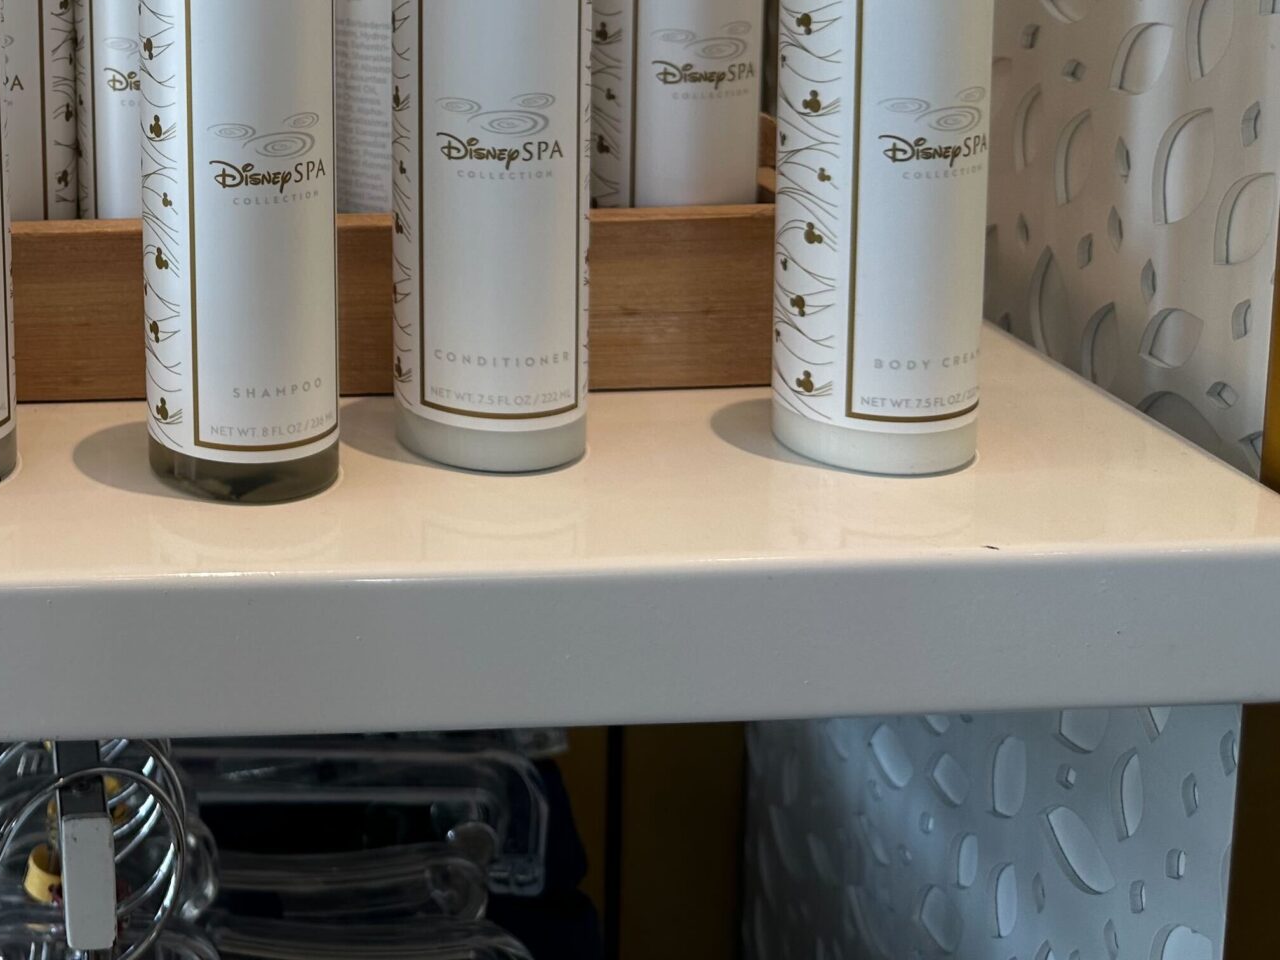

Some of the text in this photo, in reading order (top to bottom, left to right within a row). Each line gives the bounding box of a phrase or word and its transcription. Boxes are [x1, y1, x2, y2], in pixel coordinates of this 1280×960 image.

[104, 68, 141, 91] Dis
[727, 62, 756, 83] SPA
[436, 132, 564, 170] Disney SPA
[878, 133, 988, 168] Disney SPA
[209, 158, 326, 194] Disney SPA
[456, 169, 553, 180] COLLECTION
[233, 190, 319, 206] COLLECTION
[433, 349, 570, 367] CONDITIONER
[874, 358, 931, 370] BODY
[233, 377, 322, 399] SHAMPOO
[860, 396, 886, 407] NET
[210, 425, 235, 437] NET
